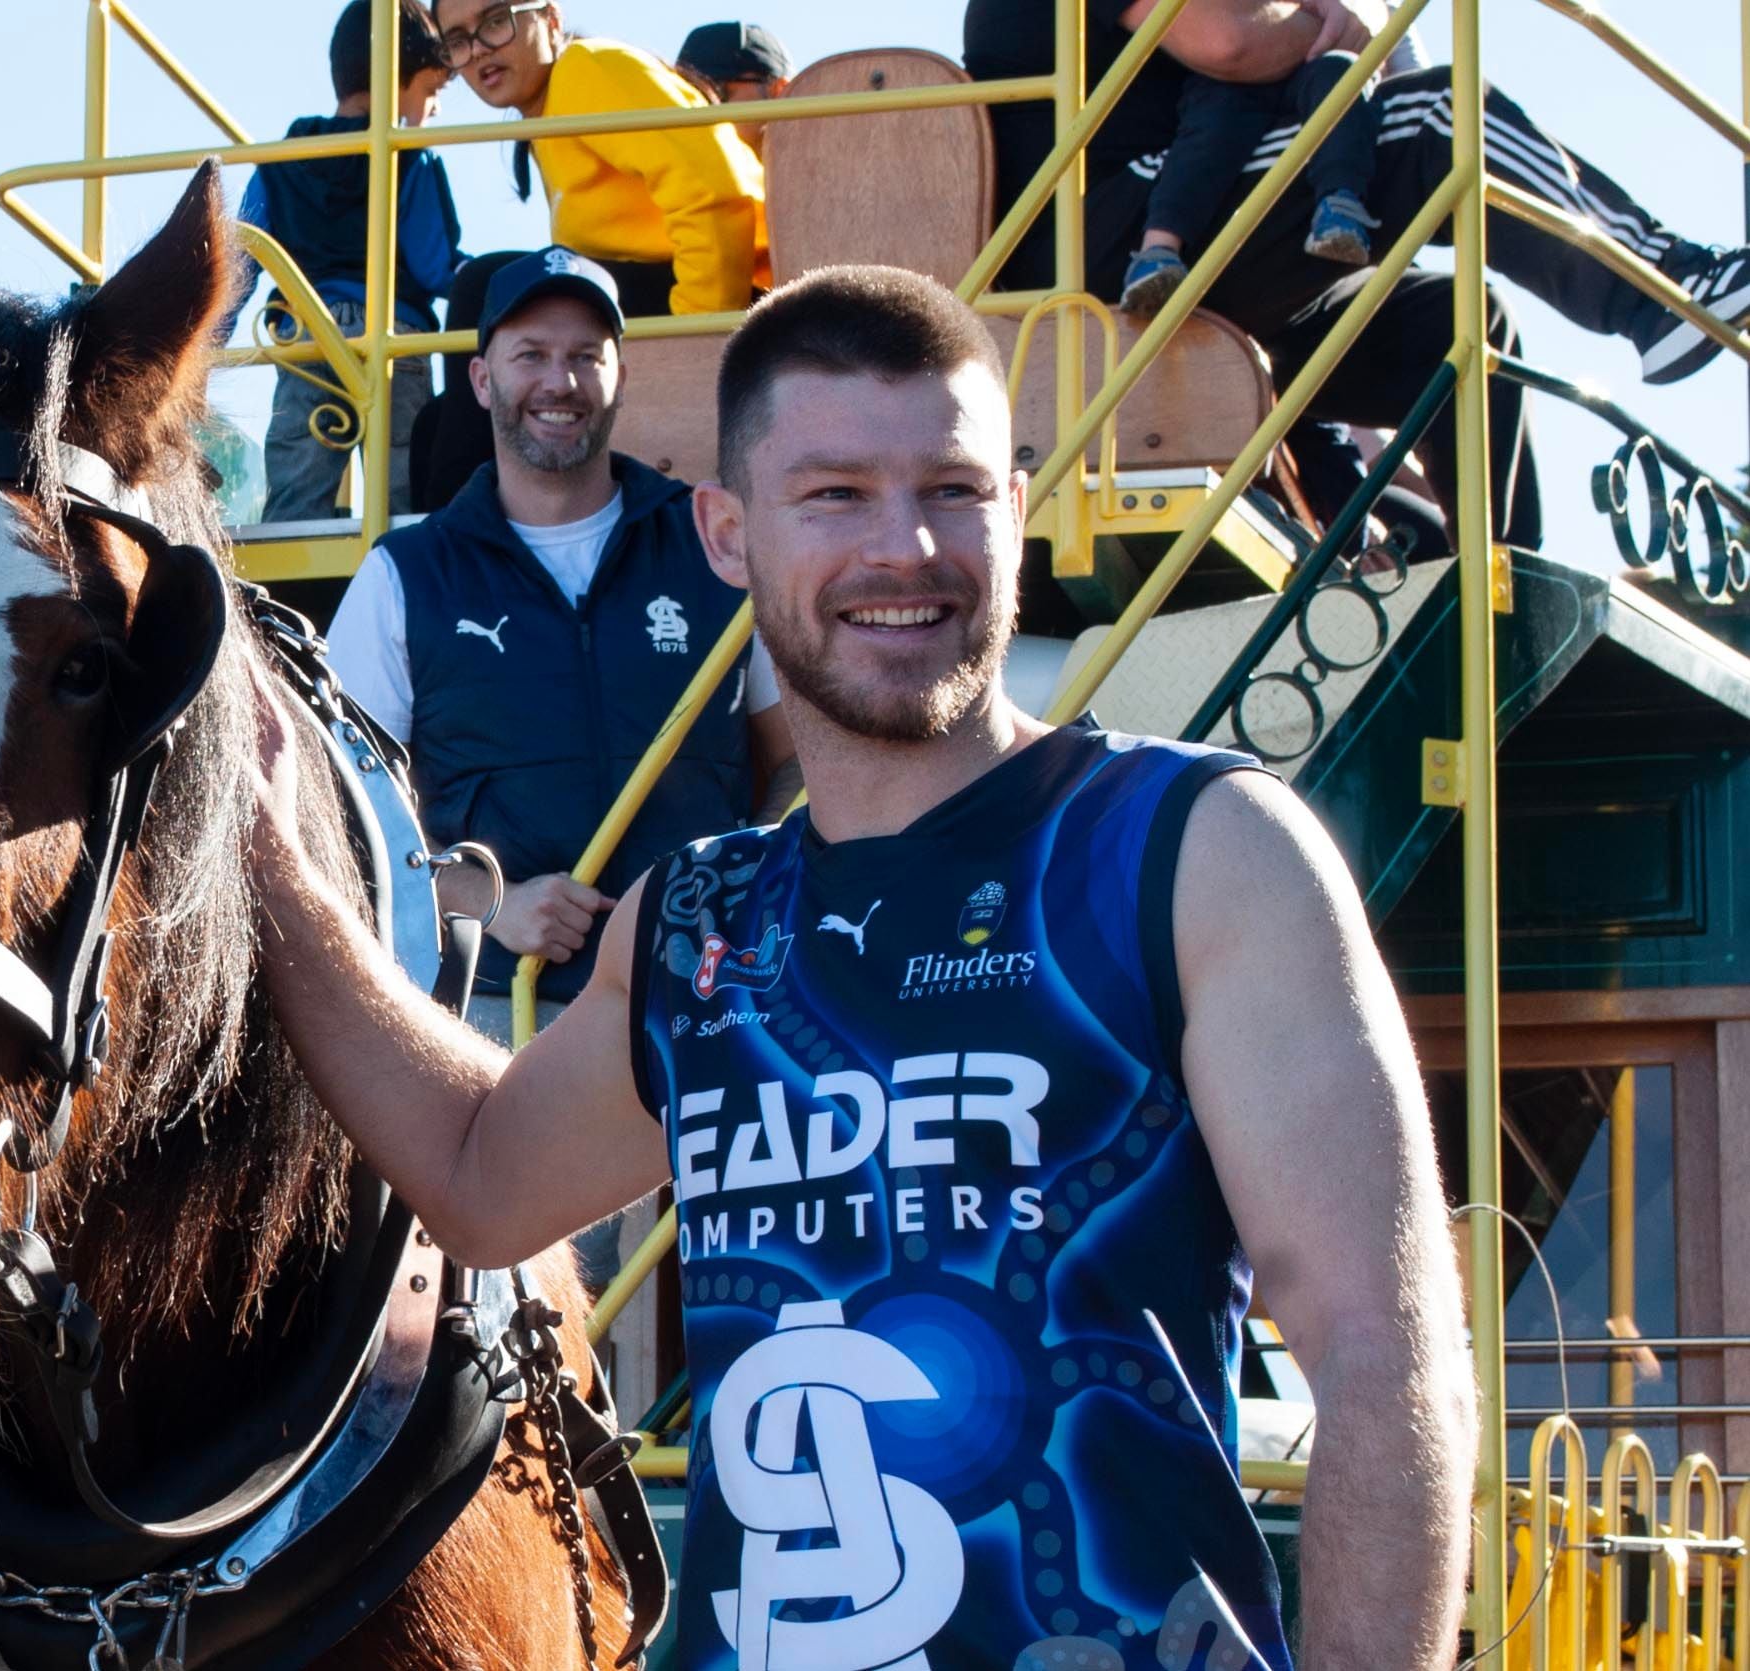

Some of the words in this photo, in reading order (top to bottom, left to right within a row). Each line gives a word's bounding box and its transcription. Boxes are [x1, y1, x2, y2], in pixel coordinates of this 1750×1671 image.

[652, 641, 689, 654] 1876
[902, 947, 1037, 987] Flinders
[898, 975, 1033, 1000] UNIVERSITY
[696, 1008, 771, 1037] Southern
[661, 1052, 1050, 1205] EADER
[679, 1186, 1046, 1265] OMPUTERS
